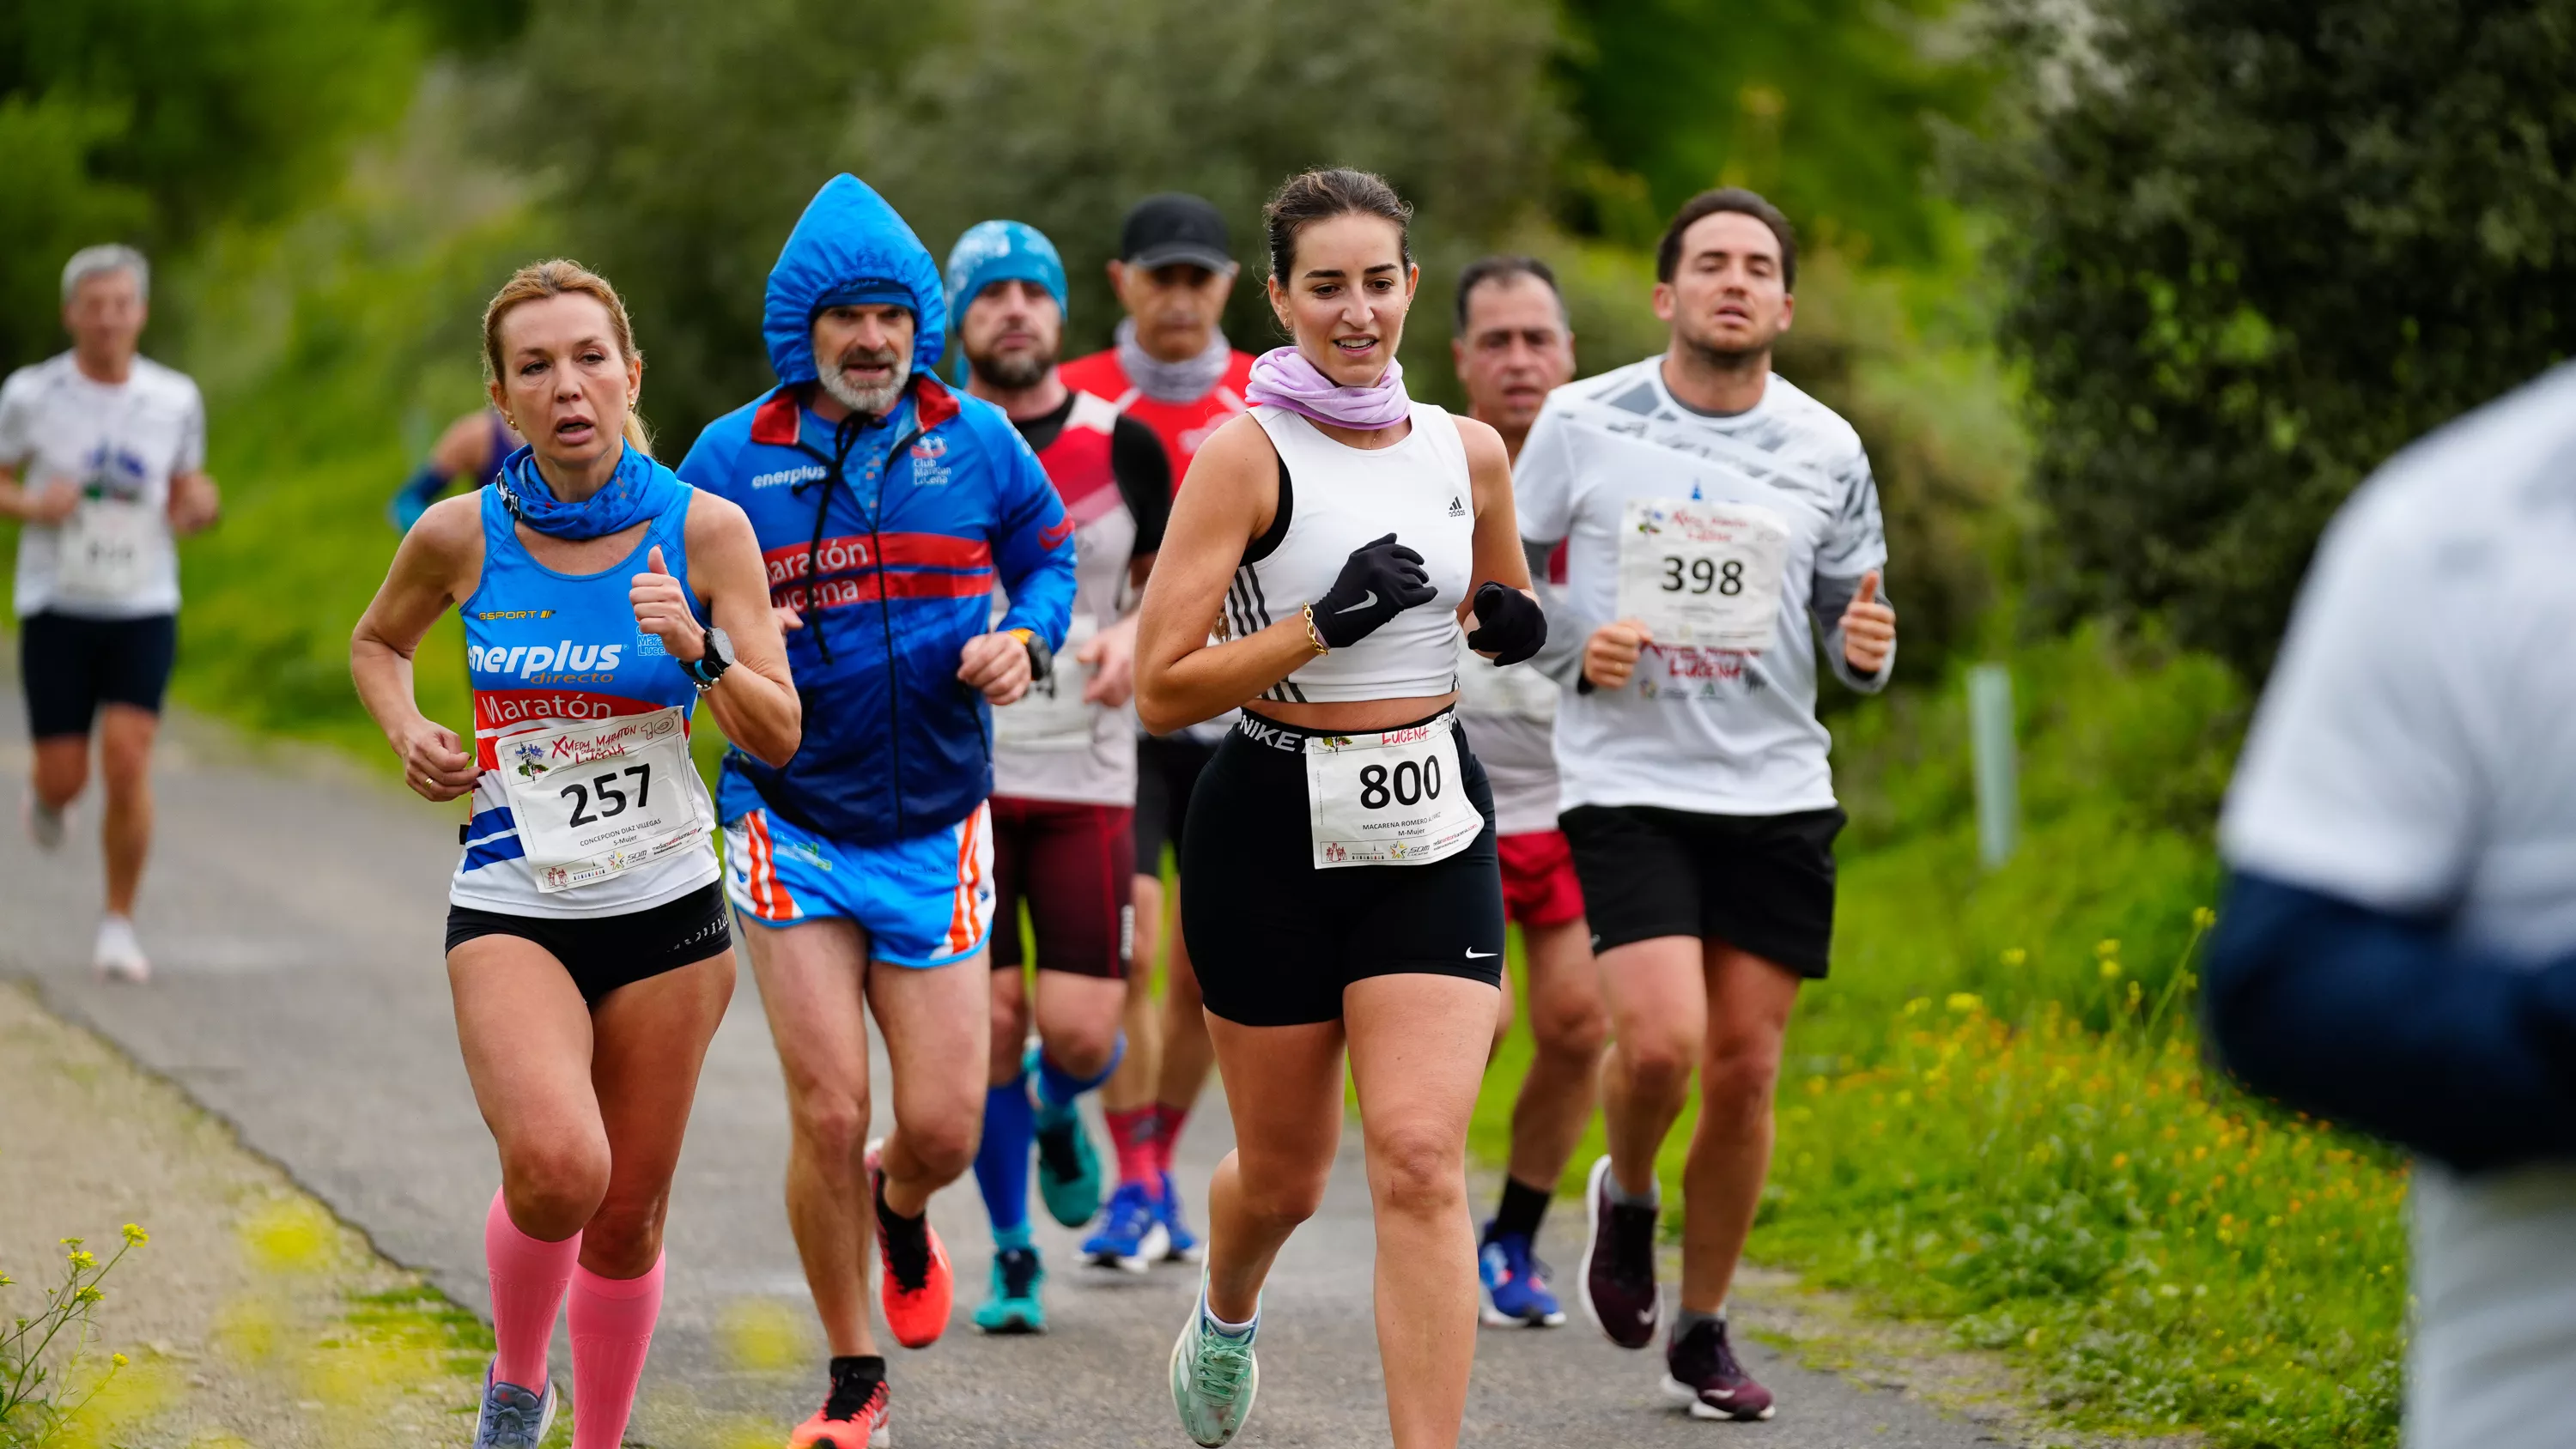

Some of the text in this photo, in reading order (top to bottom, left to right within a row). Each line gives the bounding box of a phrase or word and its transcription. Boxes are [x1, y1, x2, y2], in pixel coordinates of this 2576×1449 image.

[914, 458, 937, 467] Club
[752, 465, 827, 489] enerplus
[765, 539, 868, 586] aratón
[1662, 555, 1744, 596] 398
[637, 635, 664, 646] Mara
[530, 672, 614, 685] directo
[482, 694, 612, 724] Maratón
[1240, 714, 1303, 752] NIKE
[575, 743, 625, 765] LUCENA
[1359, 755, 1441, 809] 800
[561, 763, 650, 828] 257
[580, 818, 662, 846] CONCEPCION DIAZ VILLEGAS
[1363, 822, 1400, 830] MACARENA
[1401, 817, 1427, 827] ROMERO
[1398, 828, 1425, 837] M-Mujer
[613, 834, 638, 846] S-Mujer
